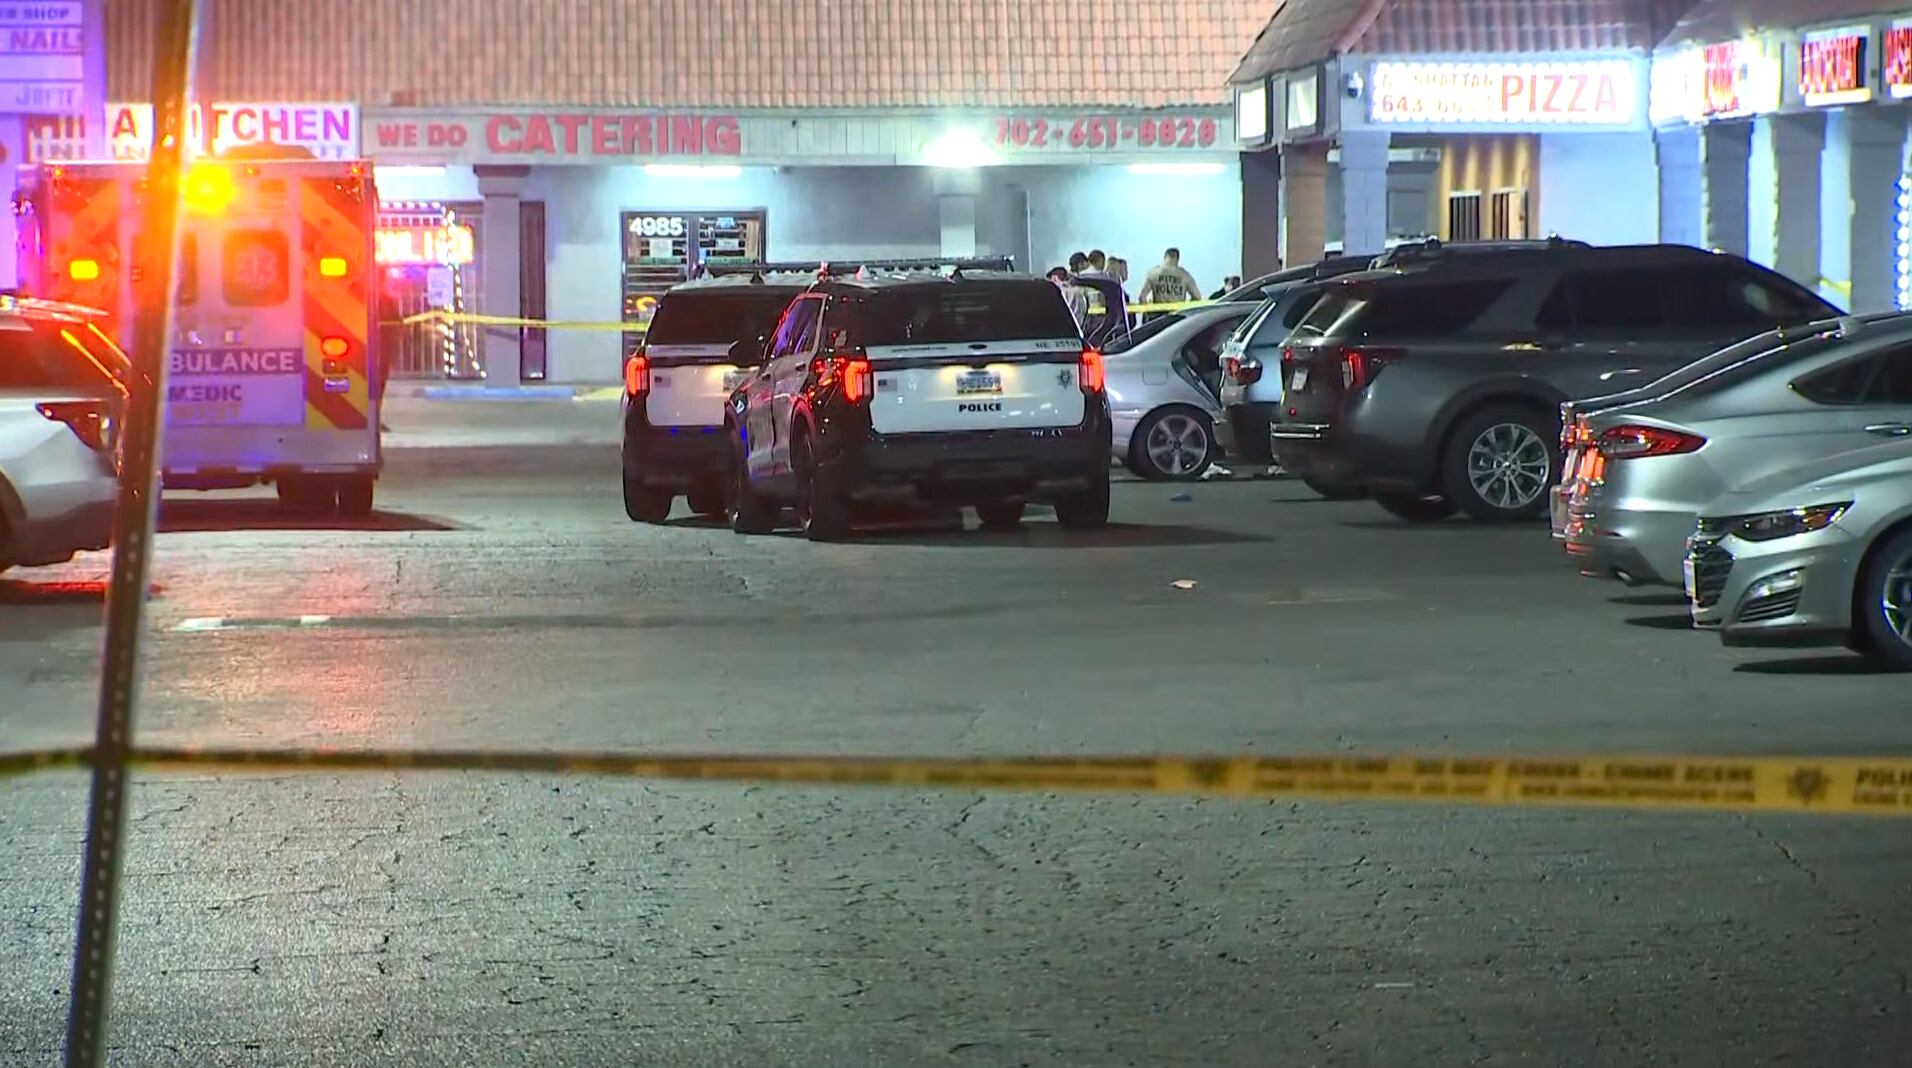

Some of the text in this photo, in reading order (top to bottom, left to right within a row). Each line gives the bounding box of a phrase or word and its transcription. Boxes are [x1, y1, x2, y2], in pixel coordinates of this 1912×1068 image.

[23, 7, 71, 19] SHOP
[1501, 74, 1617, 113] PIZZA
[190, 108, 350, 141] ITCHEN
[377, 114, 742, 155] WE DO CATERING
[629, 217, 684, 237] 4985
[169, 351, 295, 372] BULANCE
[958, 402, 1003, 413] POLICE
